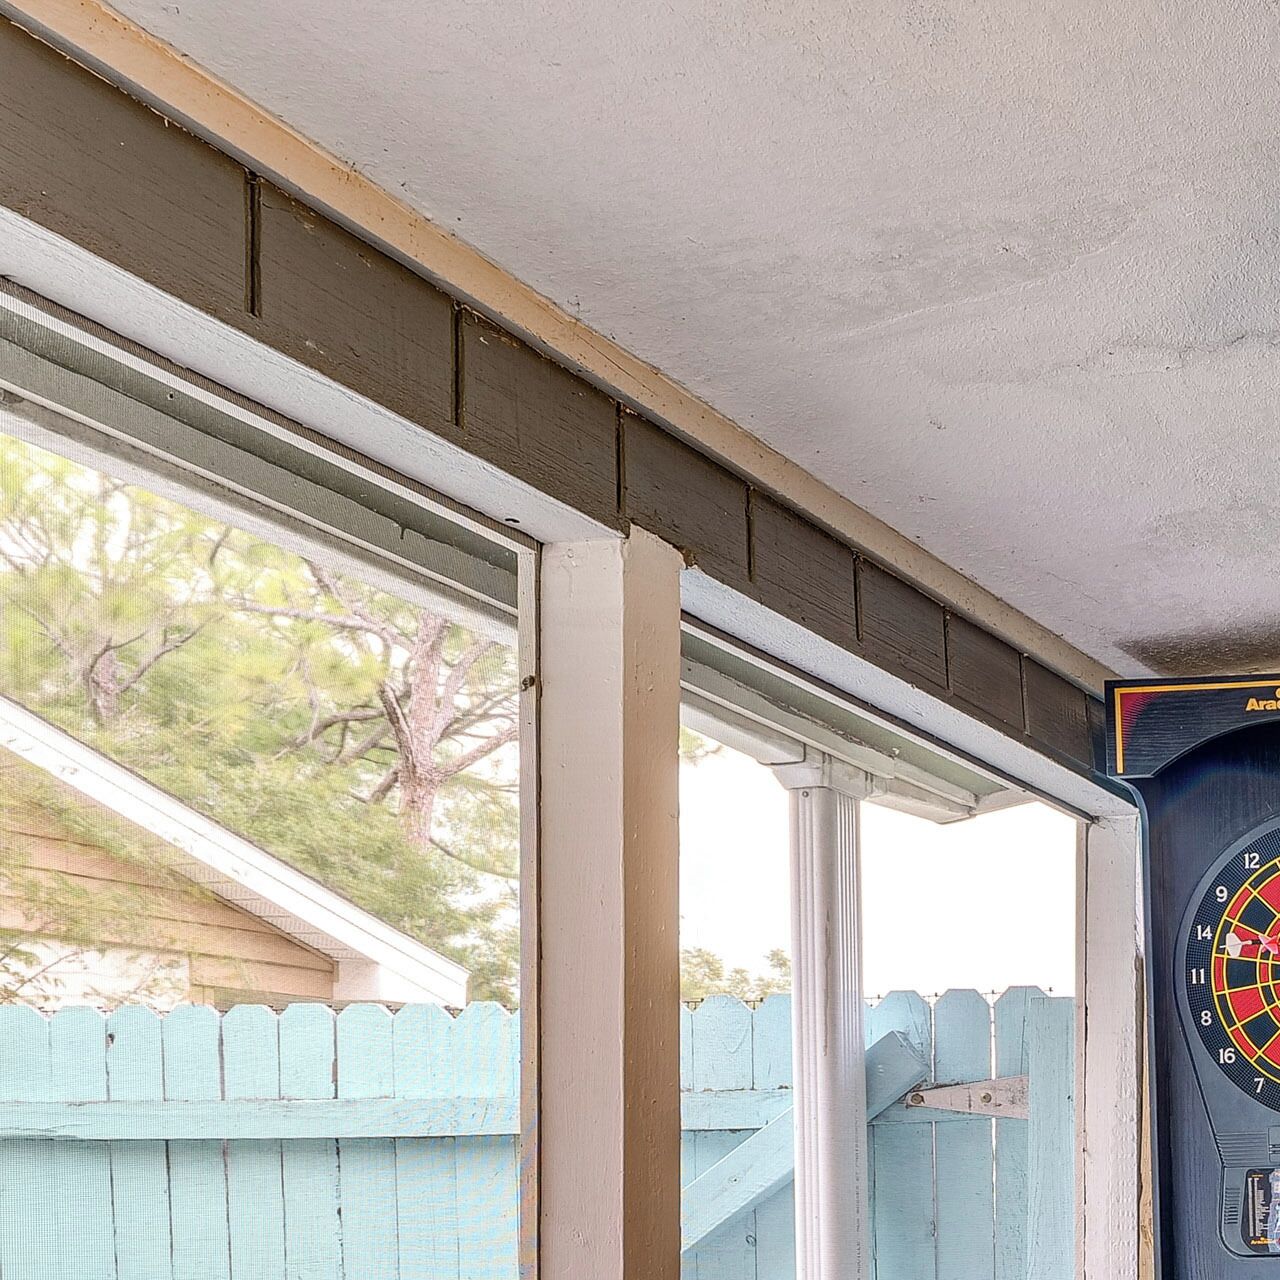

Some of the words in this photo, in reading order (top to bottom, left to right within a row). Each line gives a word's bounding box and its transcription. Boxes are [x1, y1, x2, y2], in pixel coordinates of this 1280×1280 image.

[1244, 853, 1260, 869] 12
[1215, 886, 1228, 902] 9
[1196, 924, 1213, 941] 14
[1190, 968, 1205, 984] 11
[1201, 1011, 1212, 1026] 8
[1219, 1048, 1236, 1064] 16
[1254, 1078, 1265, 1093] 7
